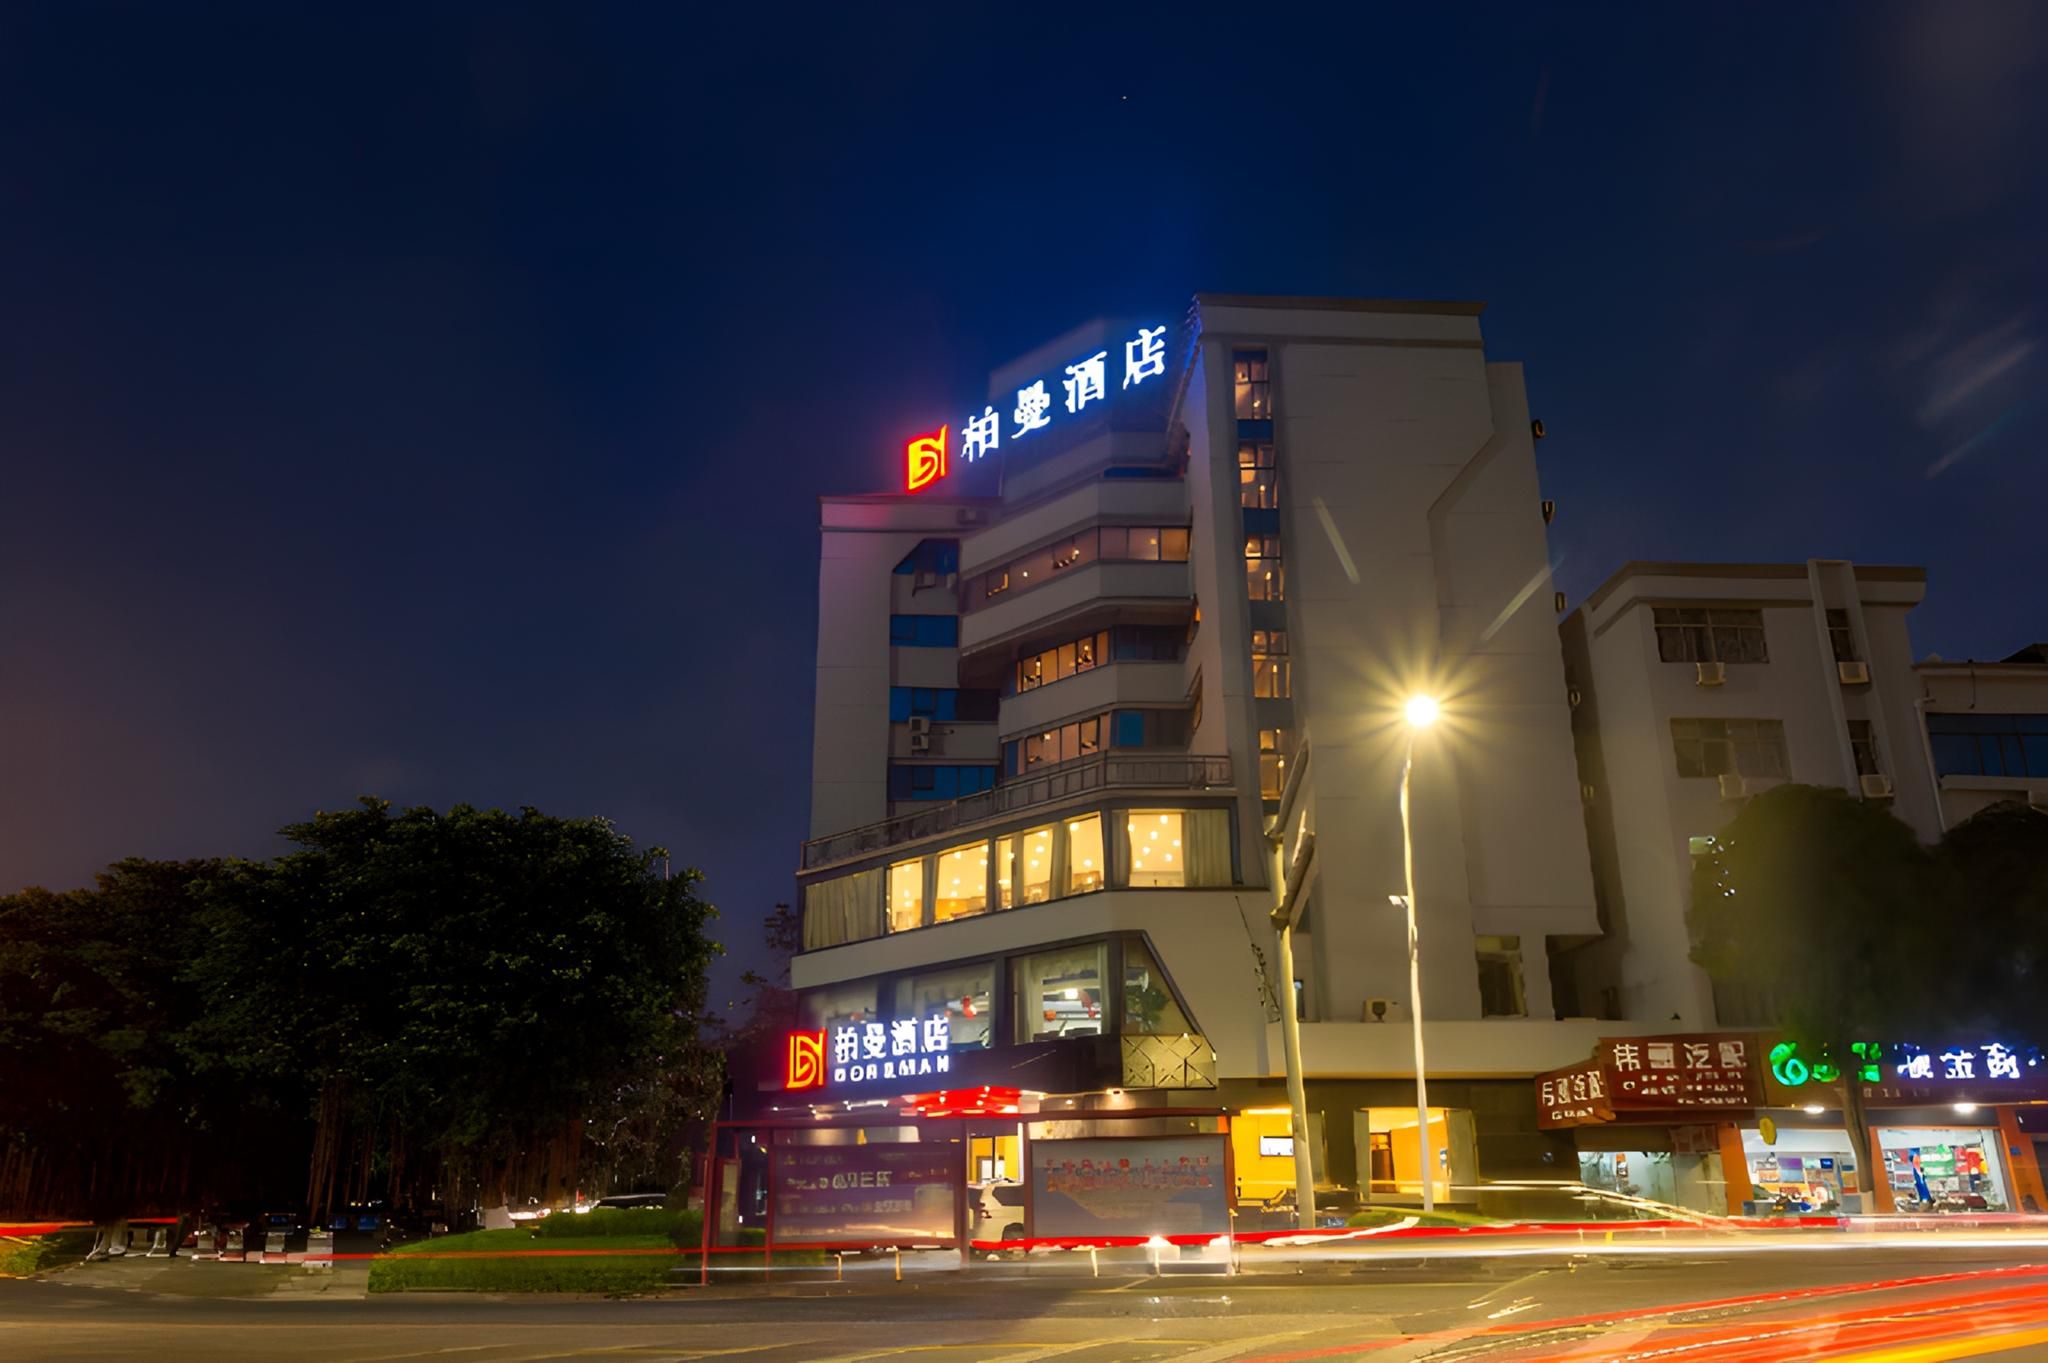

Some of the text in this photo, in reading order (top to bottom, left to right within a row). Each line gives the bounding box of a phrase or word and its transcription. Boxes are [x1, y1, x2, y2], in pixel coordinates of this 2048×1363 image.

[961, 325, 1166, 462] 柏曼酒店
[834, 1014, 949, 1064] 柏曼酒店
